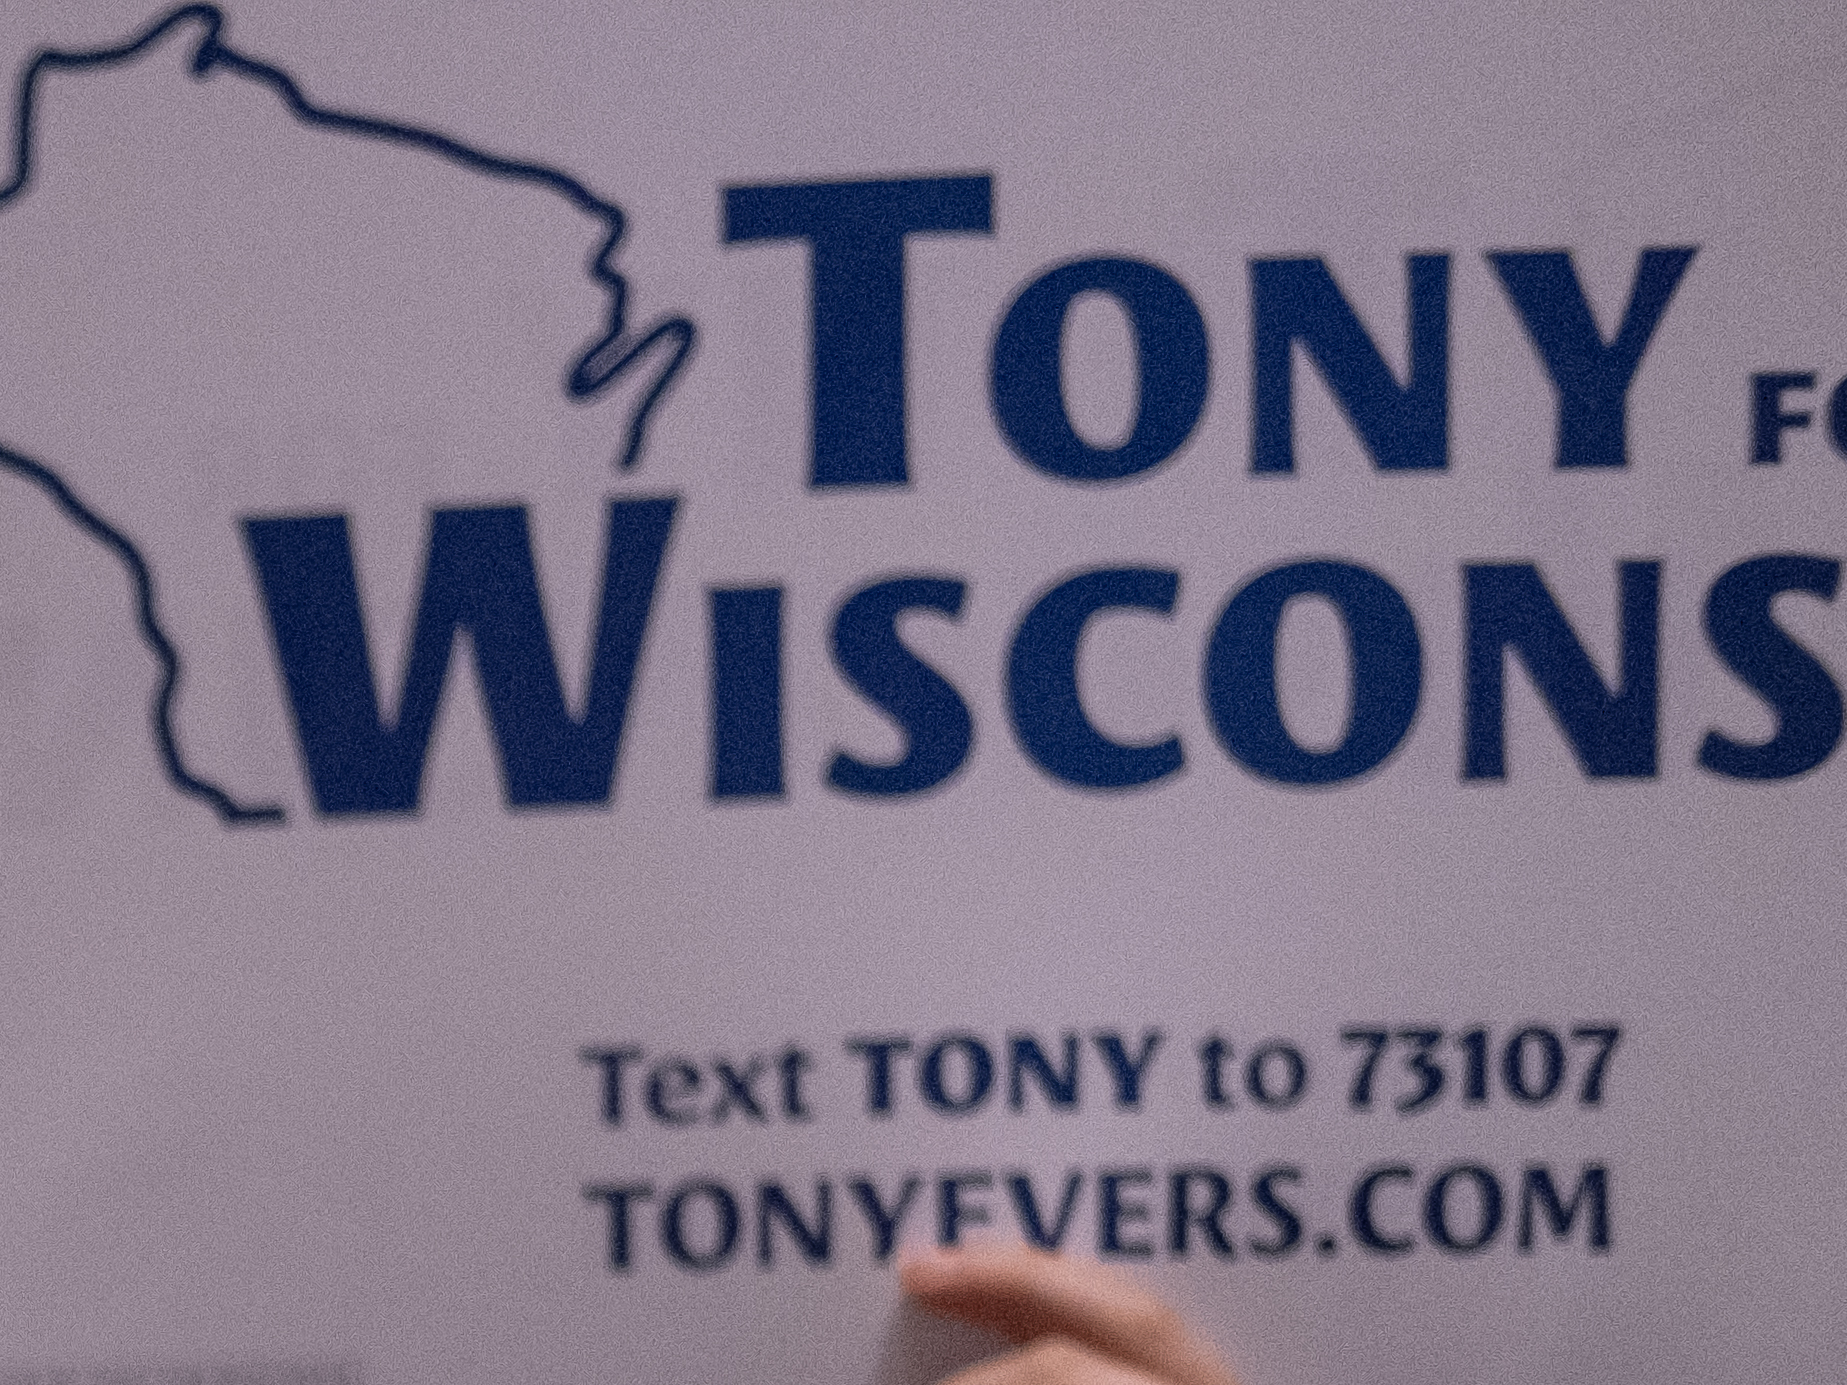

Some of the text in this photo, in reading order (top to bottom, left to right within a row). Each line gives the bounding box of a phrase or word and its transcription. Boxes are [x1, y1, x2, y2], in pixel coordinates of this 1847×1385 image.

[719, 172, 1700, 491] TONY
[578, 1022, 1625, 1129] Text TONY to 73107
